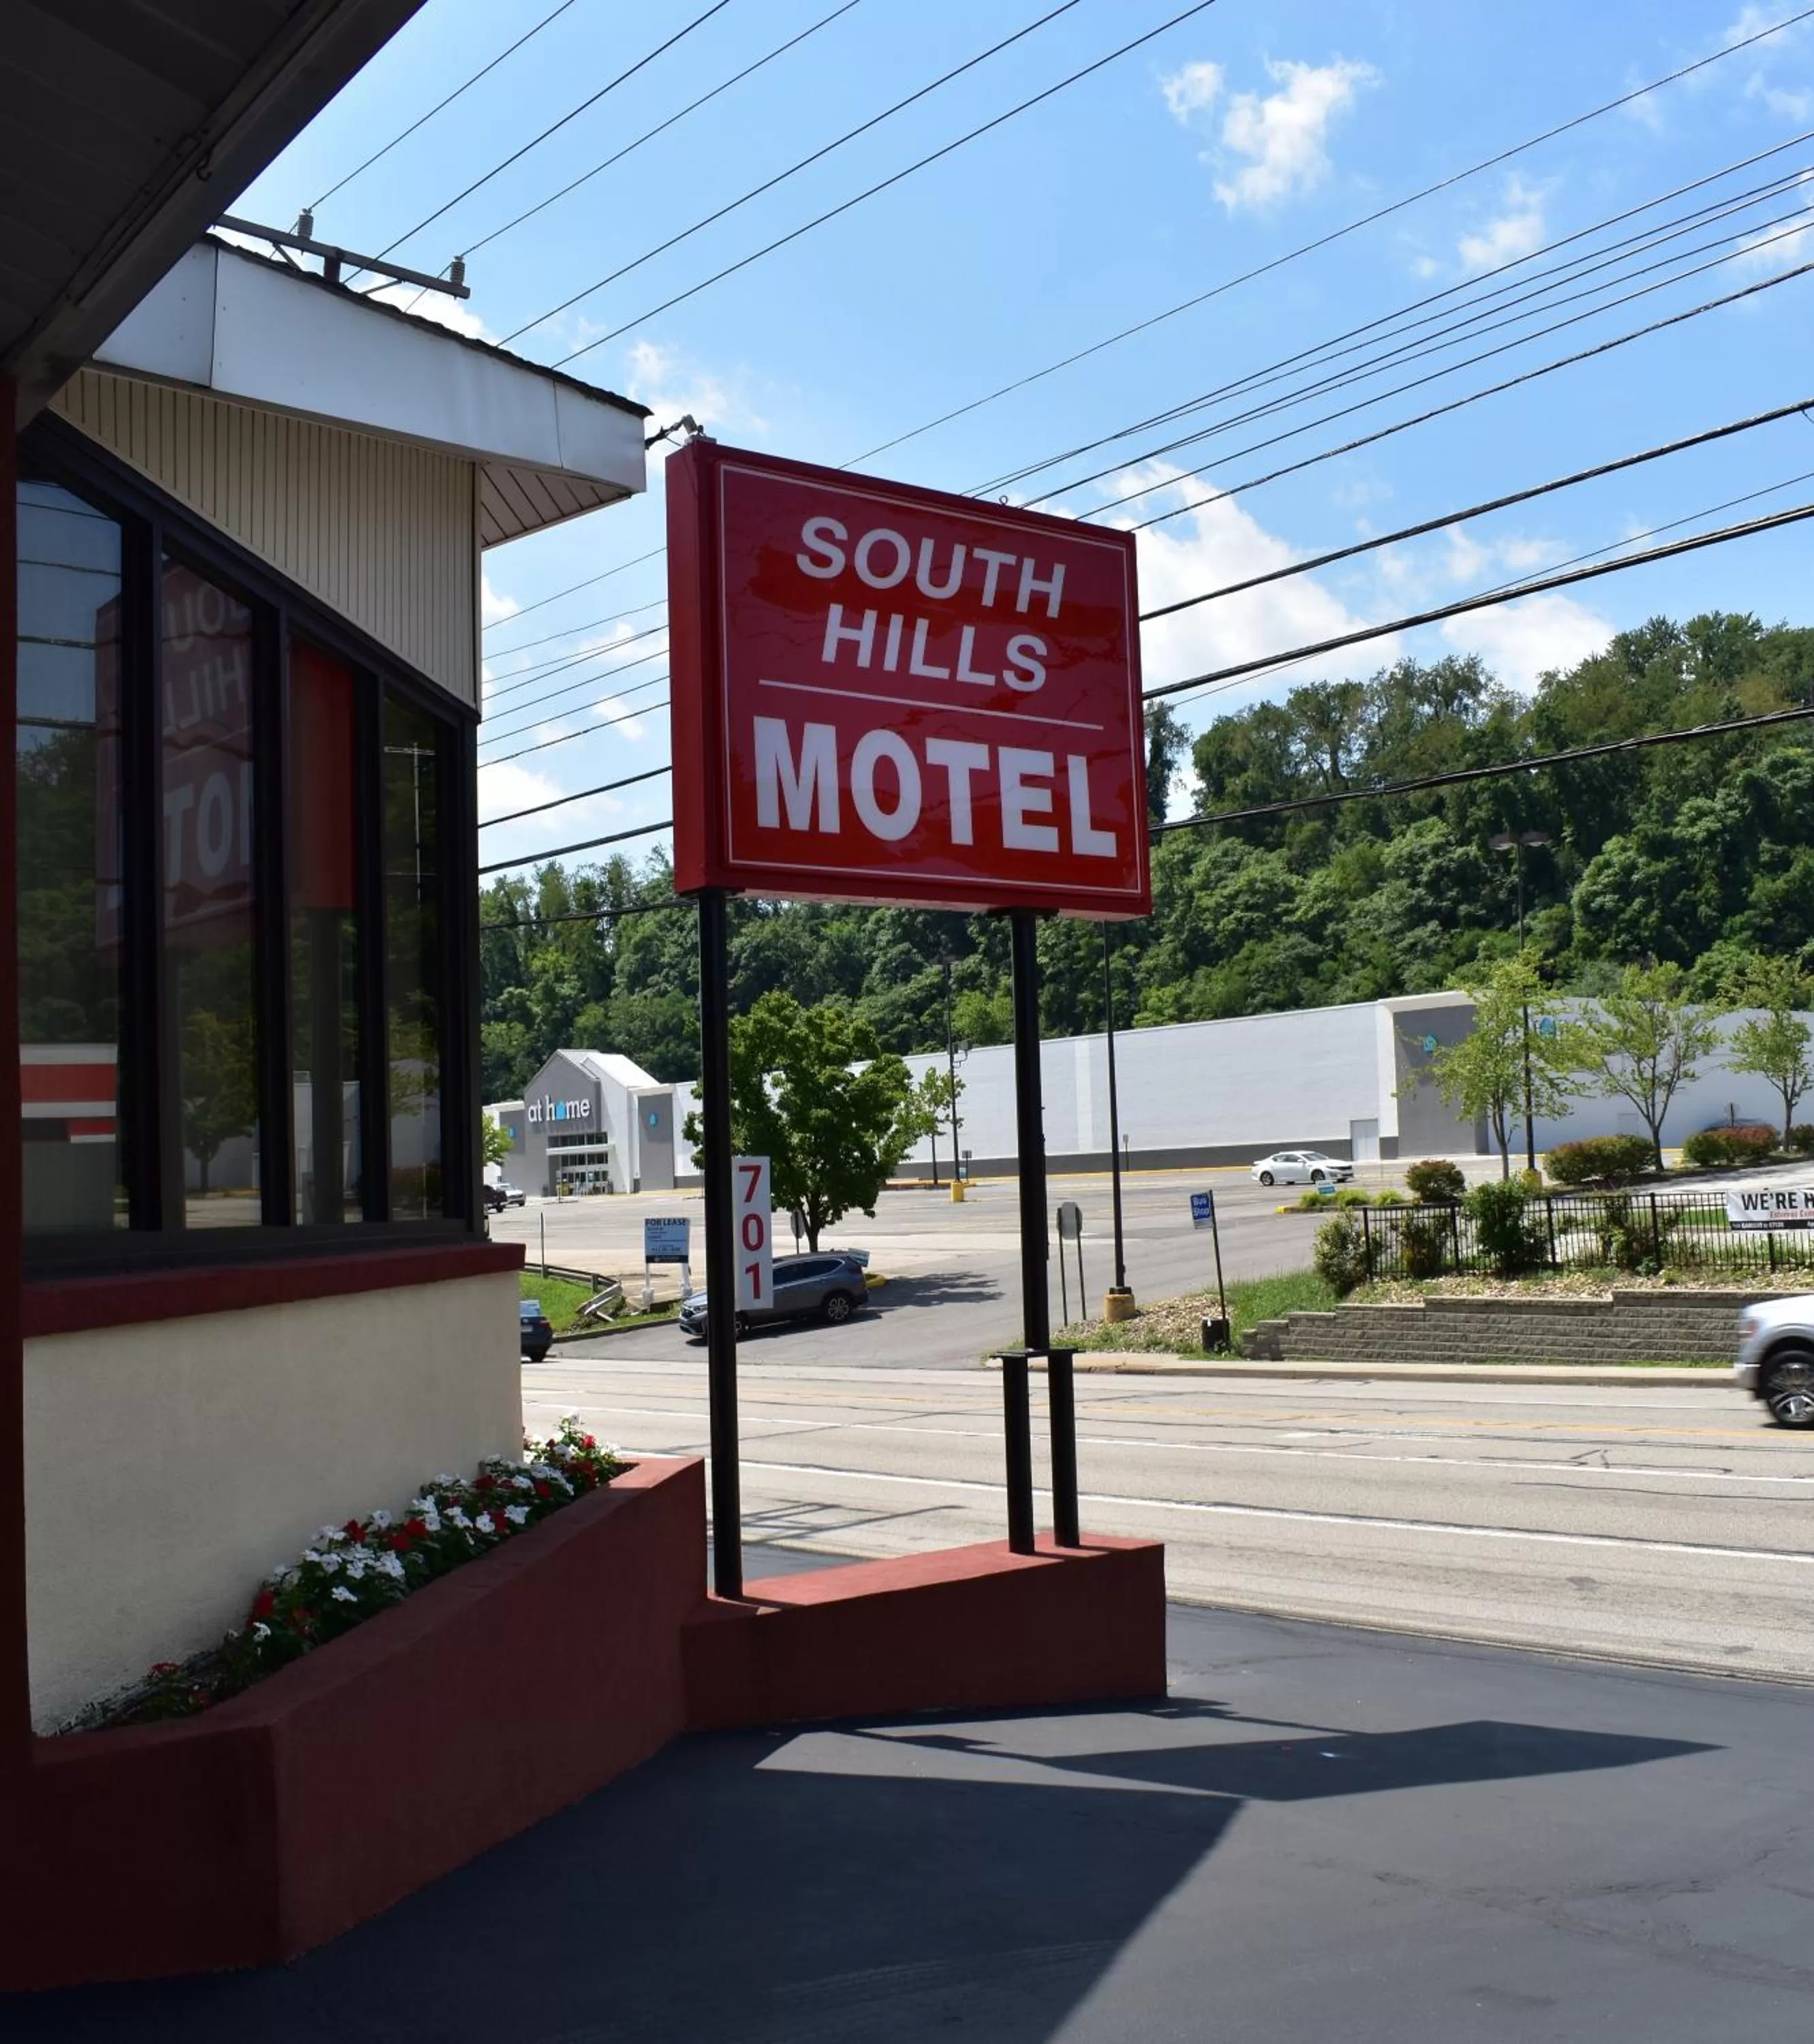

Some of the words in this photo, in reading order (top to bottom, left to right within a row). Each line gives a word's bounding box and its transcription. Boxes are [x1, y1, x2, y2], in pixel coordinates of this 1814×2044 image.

[797, 516, 1066, 619] SOUTH
[822, 603, 1047, 693] HILLS
[753, 715, 1118, 858] MOTEL
[528, 1098, 542, 1123] at
[645, 1218, 662, 1226] FOR
[663, 1218, 688, 1226] LEASE
[1741, 1192, 1798, 1211] WE'RE
